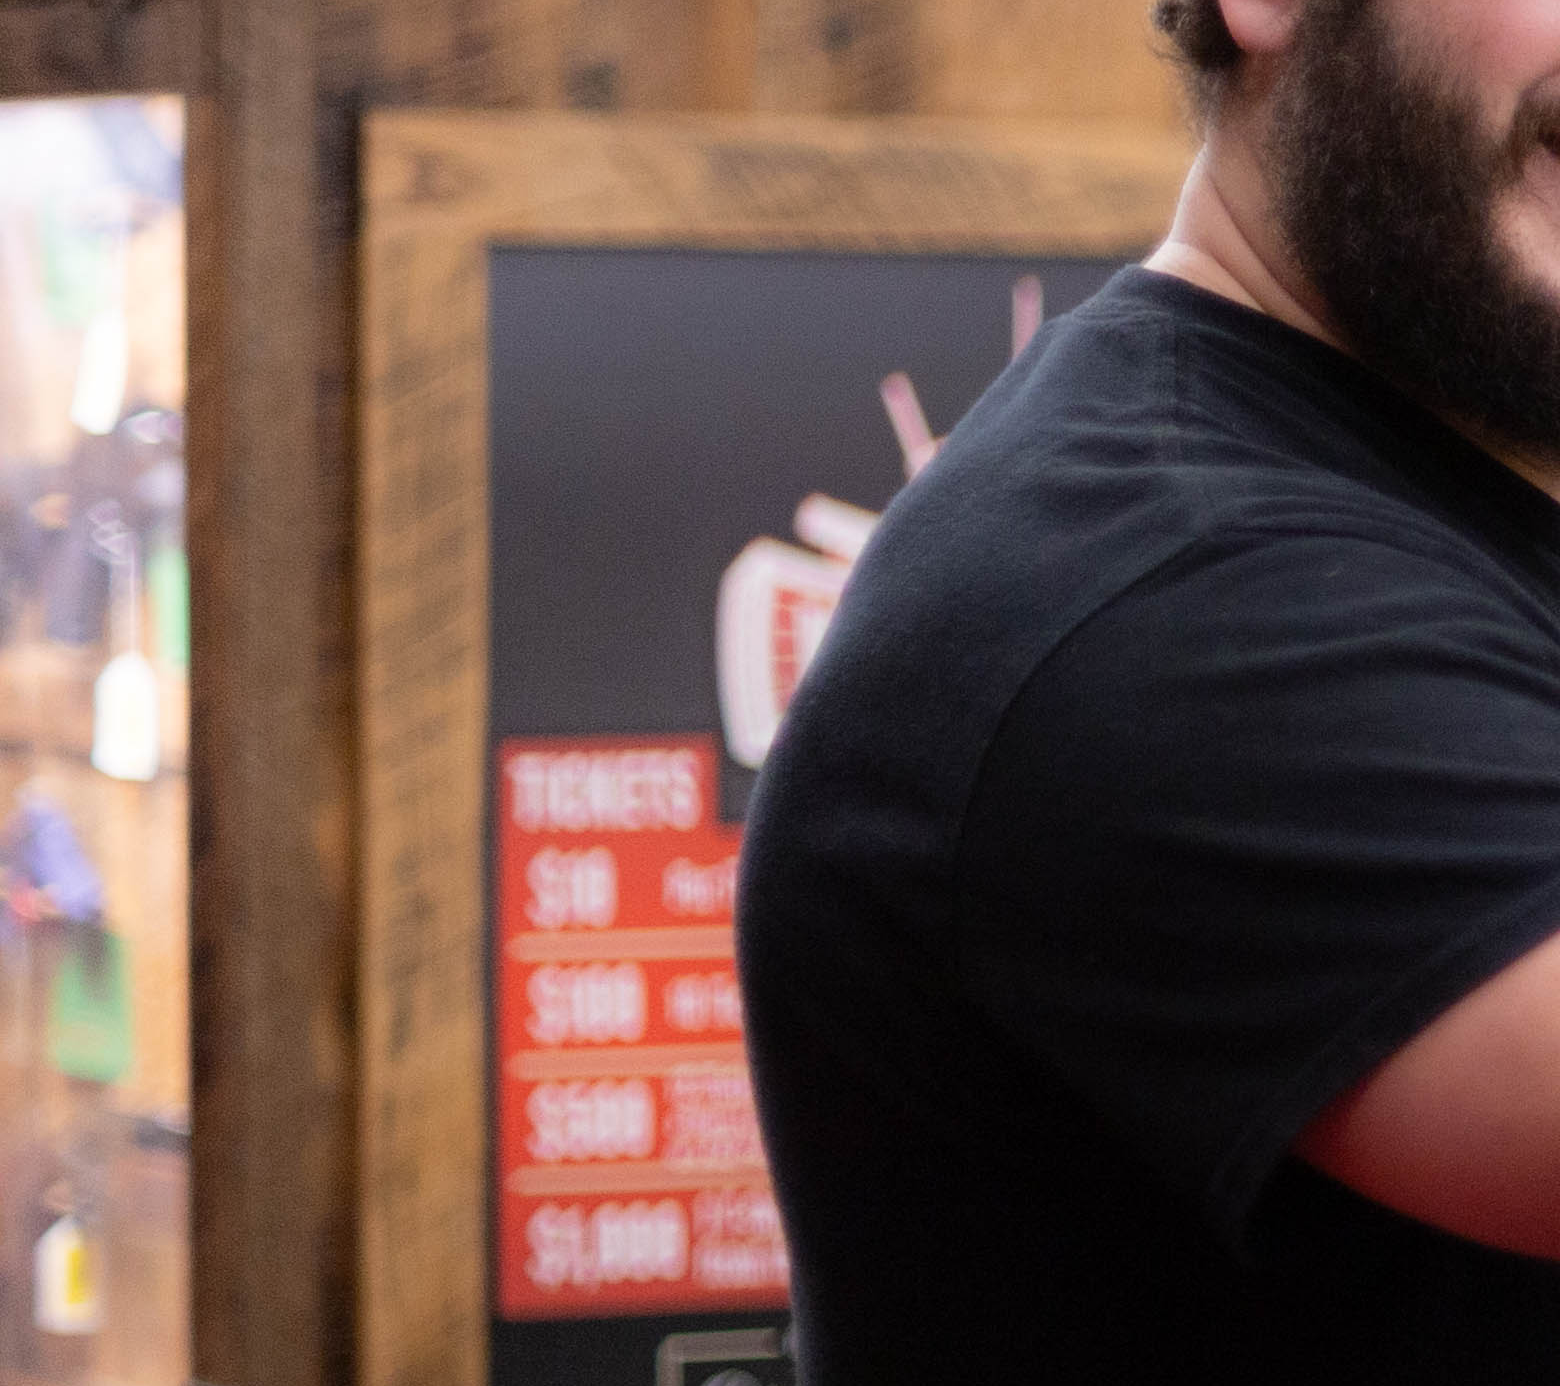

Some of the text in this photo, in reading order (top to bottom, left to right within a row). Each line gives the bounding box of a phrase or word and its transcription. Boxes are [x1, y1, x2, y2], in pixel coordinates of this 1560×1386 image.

[508, 750, 702, 833] TICKETS
[525, 848, 617, 930] $10
[525, 962, 648, 1045] $100
[526, 1078, 656, 1161] $500
[526, 1198, 689, 1295] $1,000
